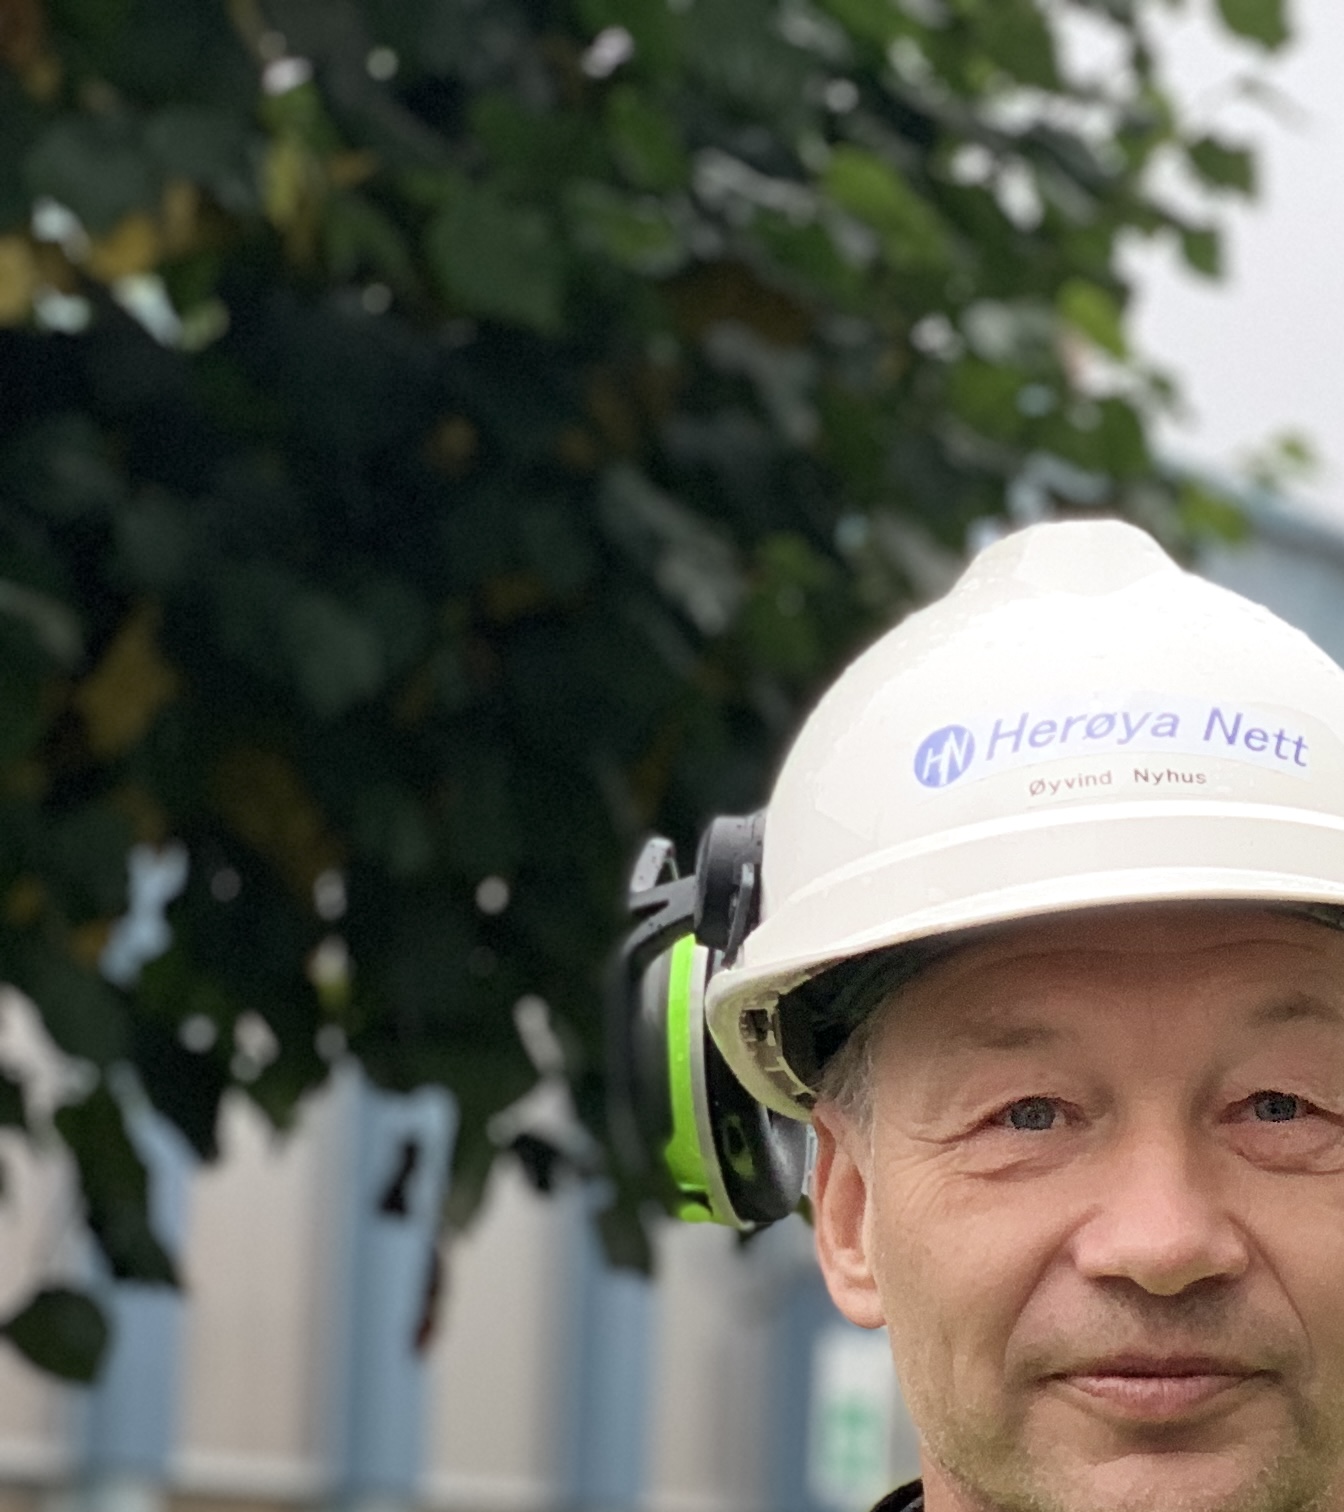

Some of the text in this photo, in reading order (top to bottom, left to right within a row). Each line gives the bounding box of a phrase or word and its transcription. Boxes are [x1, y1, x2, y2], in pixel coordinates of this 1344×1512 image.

[986, 710, 1181, 762] Herøya
[1202, 706, 1310, 768] Nett
[1028, 767, 1208, 797] Øyvind Nyhus
